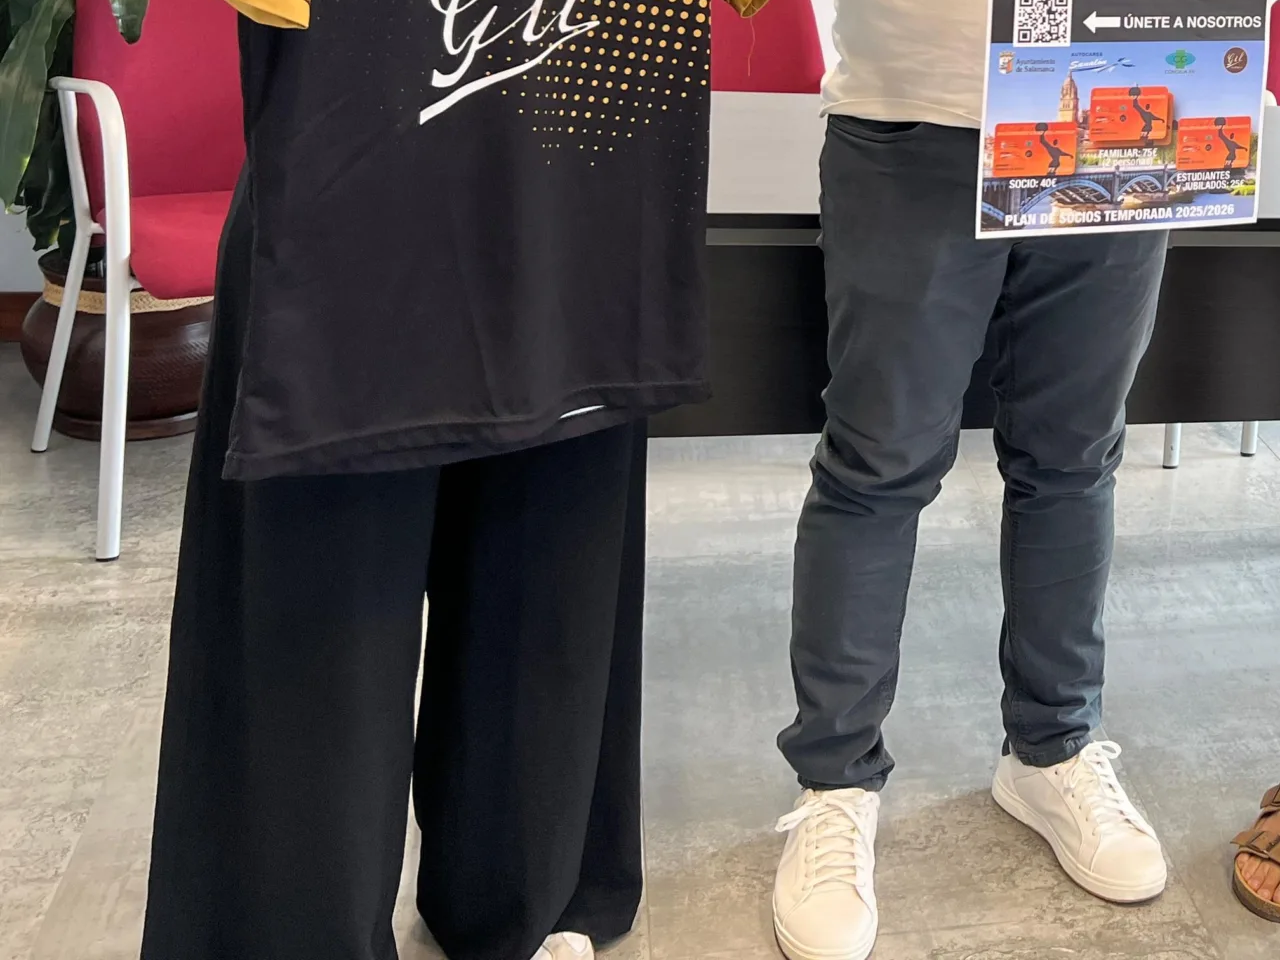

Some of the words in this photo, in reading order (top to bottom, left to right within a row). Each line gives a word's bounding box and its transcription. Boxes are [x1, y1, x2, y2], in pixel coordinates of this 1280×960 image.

[1123, 14, 1170, 29] ÚNETE
[1173, 17, 1184, 28] A
[1186, 16, 1262, 29] NOSOTROS
[1016, 58, 1056, 66] Ayuntamiento
[1016, 65, 1023, 73] de
[1024, 65, 1055, 73] Salamanca
[1098, 148, 1142, 158] FAMILIAR:
[1143, 147, 1158, 157] 75€
[1176, 171, 1231, 182] ESTUDIANTES
[1009, 178, 1039, 189] SOCIO:
[1040, 178, 1058, 188] 40€
[1182, 180, 1229, 191] JUBILADOS:
[1004, 212, 1037, 227] PLAN
[1040, 212, 1055, 225] DE
[1059, 211, 1102, 225] SOCIOS
[1103, 207, 1173, 222] TEMPORADA
[1175, 204, 1235, 219] 2025/2026
